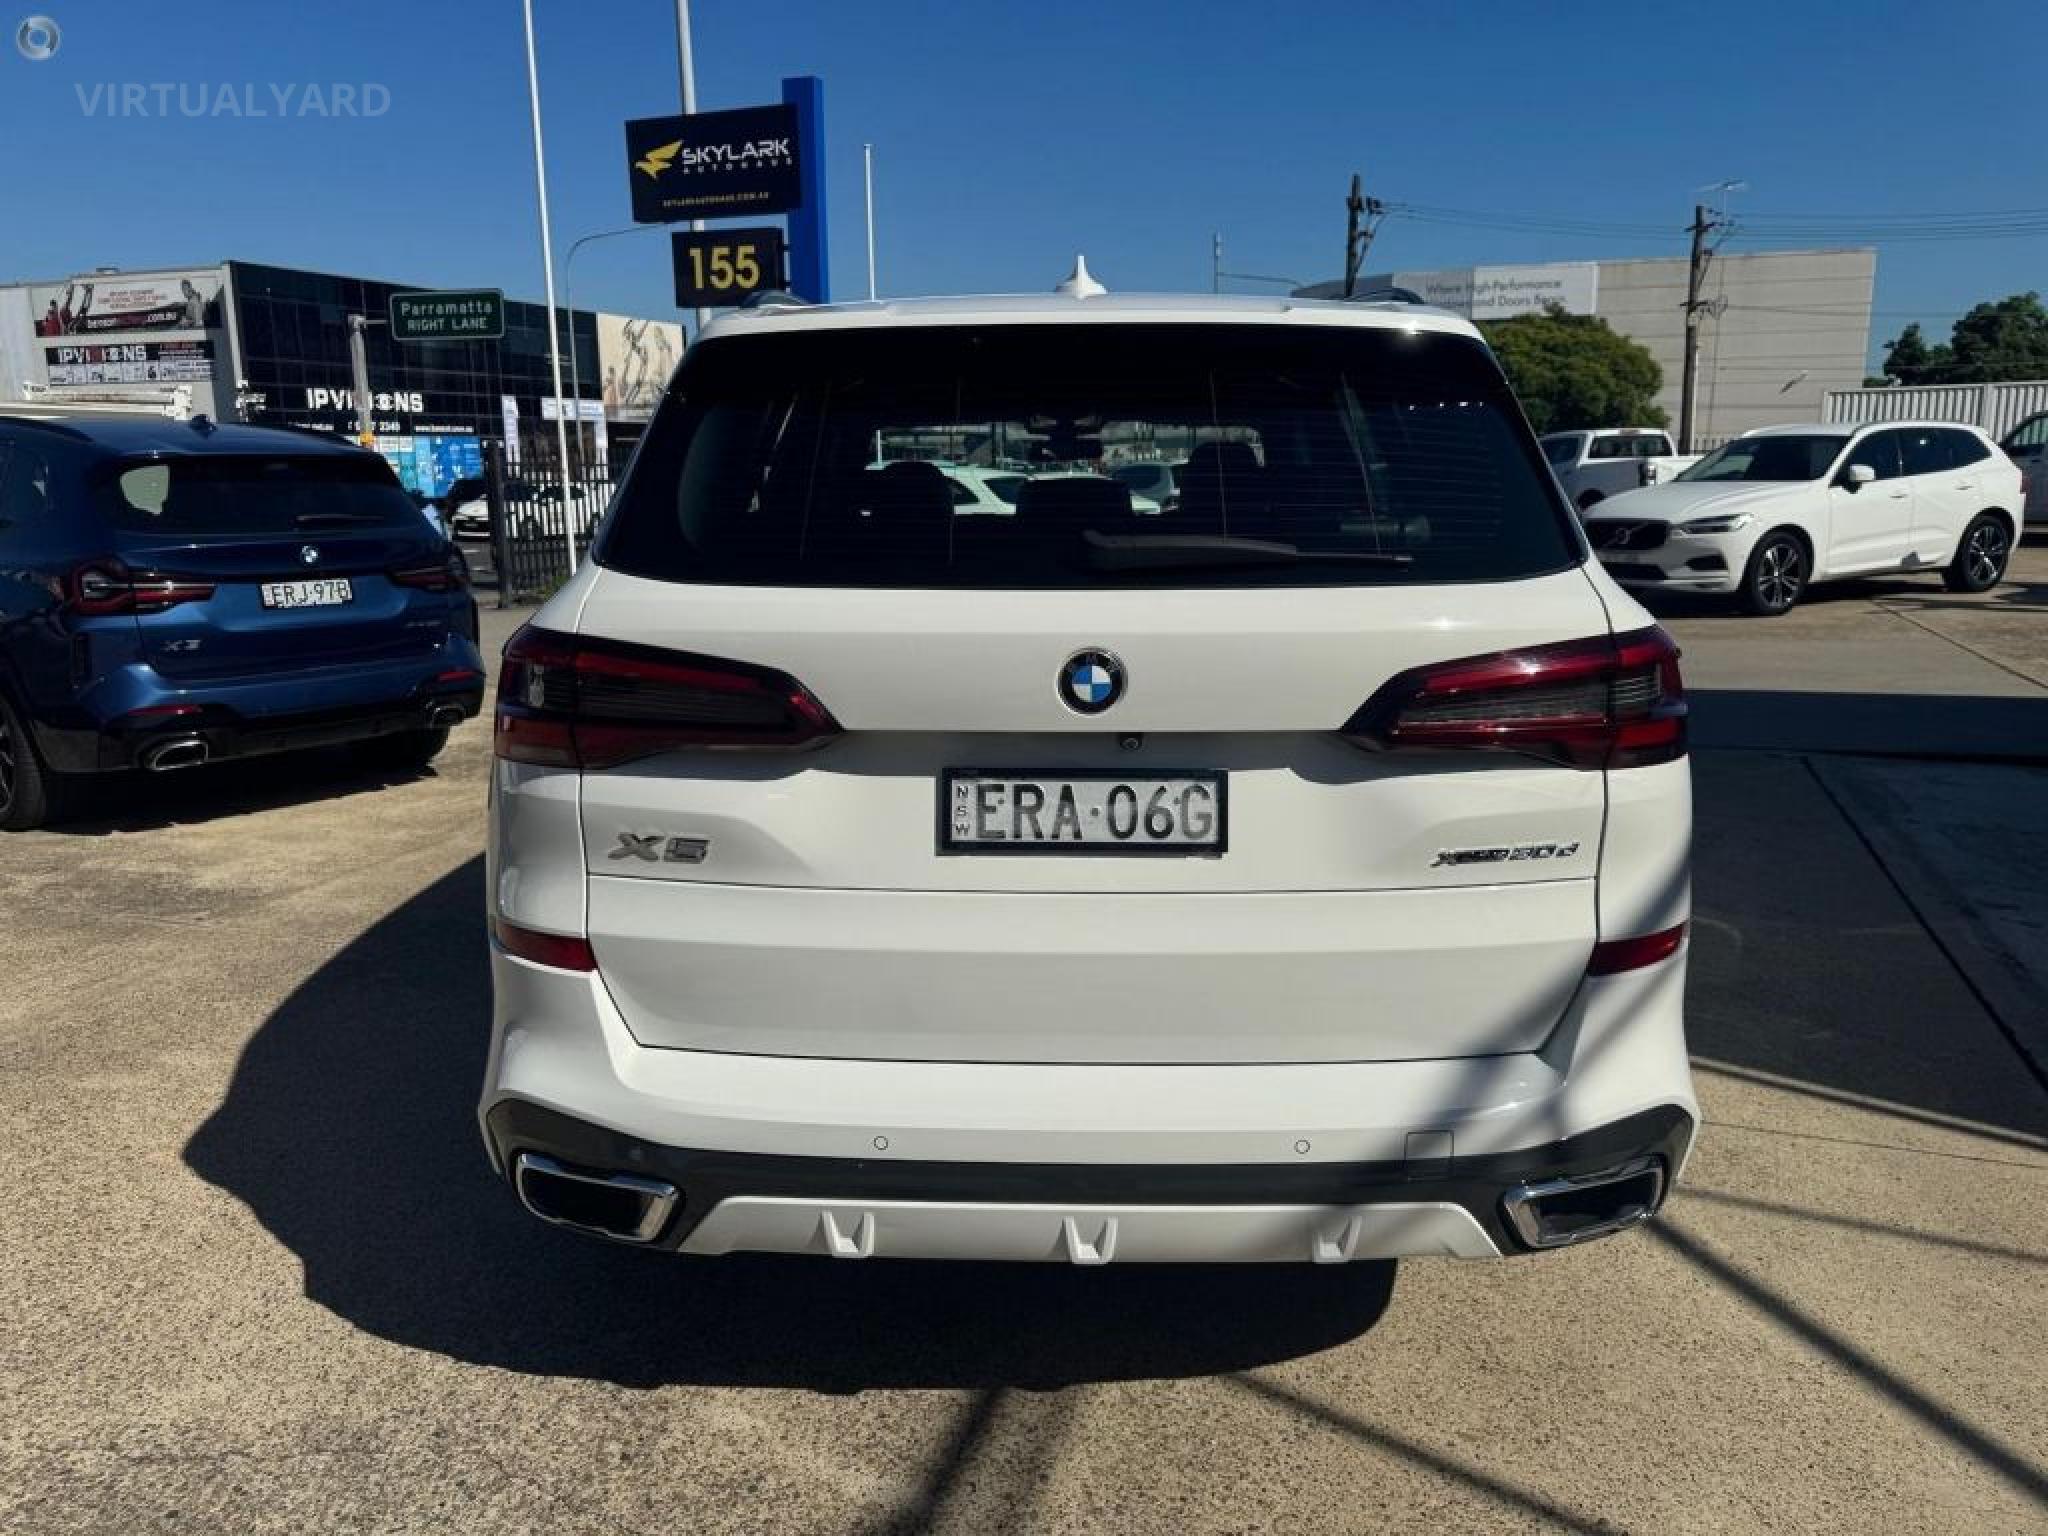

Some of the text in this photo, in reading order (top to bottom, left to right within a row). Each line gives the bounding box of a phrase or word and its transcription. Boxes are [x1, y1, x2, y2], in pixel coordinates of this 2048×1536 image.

[682, 138, 790, 165] SKYLARK
[688, 245, 761, 289] 155
[401, 300, 493, 317] Parramatta
[408, 317, 488, 332] RIGHT LANE
[607, 832, 710, 864] X5
